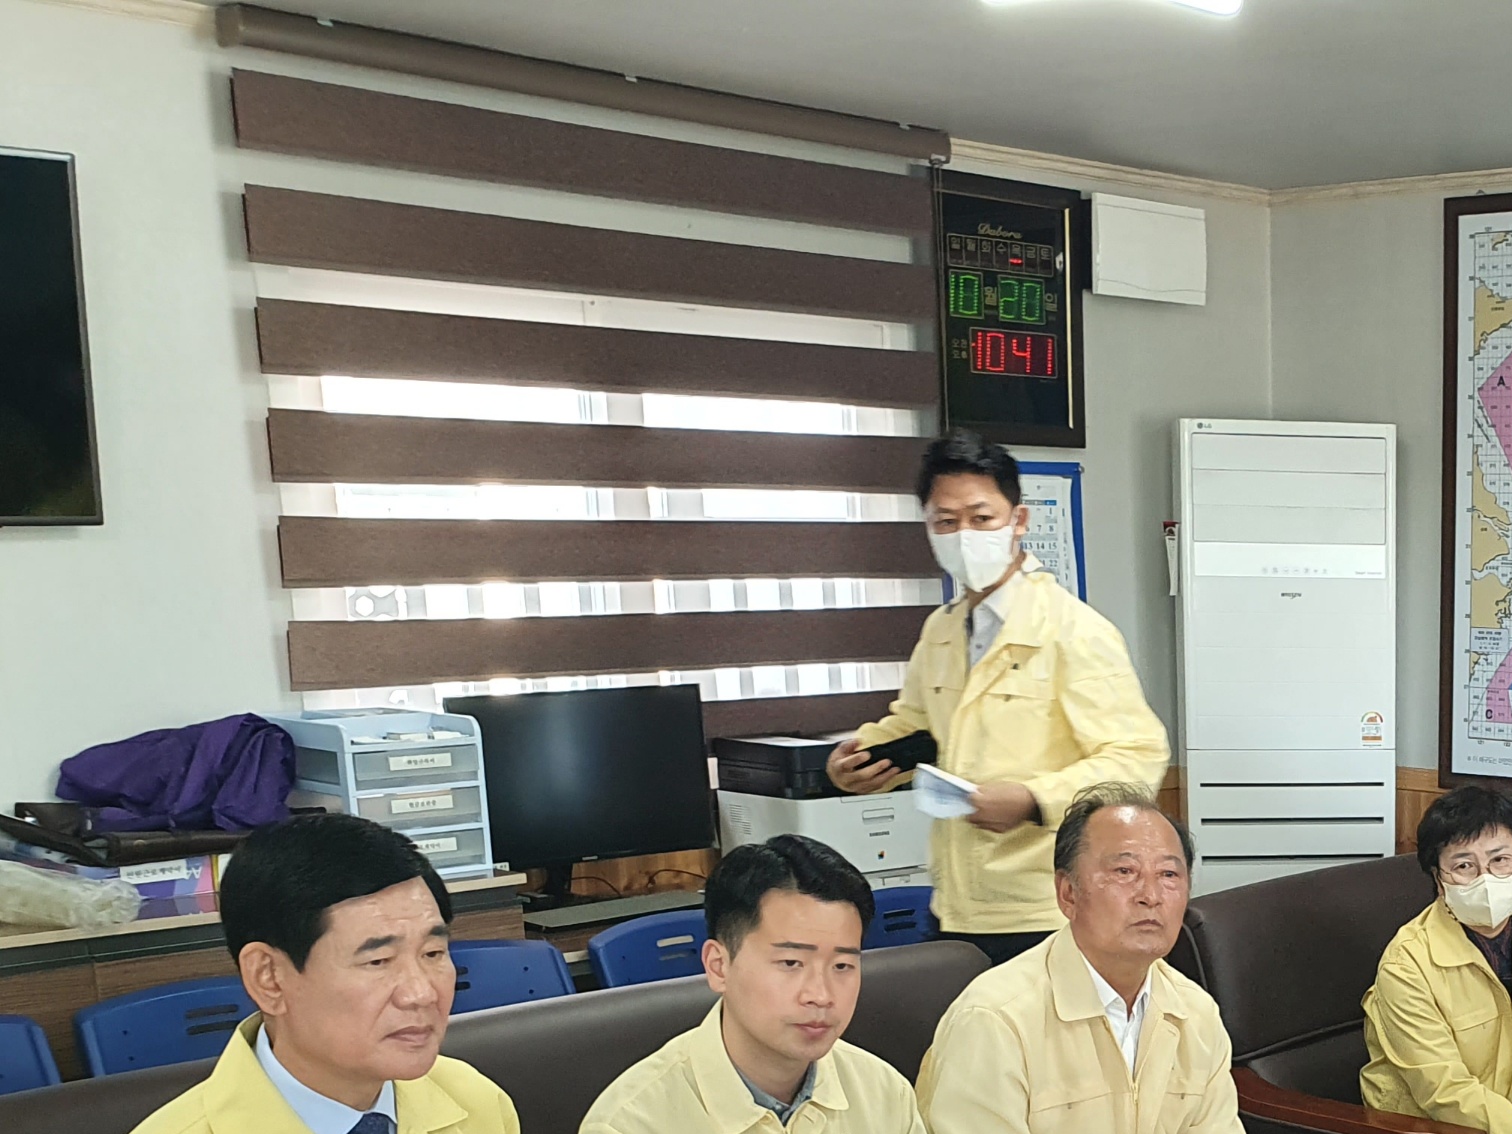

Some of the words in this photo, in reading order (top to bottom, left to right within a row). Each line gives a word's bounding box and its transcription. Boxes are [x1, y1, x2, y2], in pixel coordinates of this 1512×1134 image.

[950, 274, 979, 315] 10
[985, 286, 997, 306] 월
[1000, 280, 1041, 321] 20
[1045, 293, 1058, 312] 일
[1497, 376, 1506, 386] A
[1485, 709, 1493, 719] C
